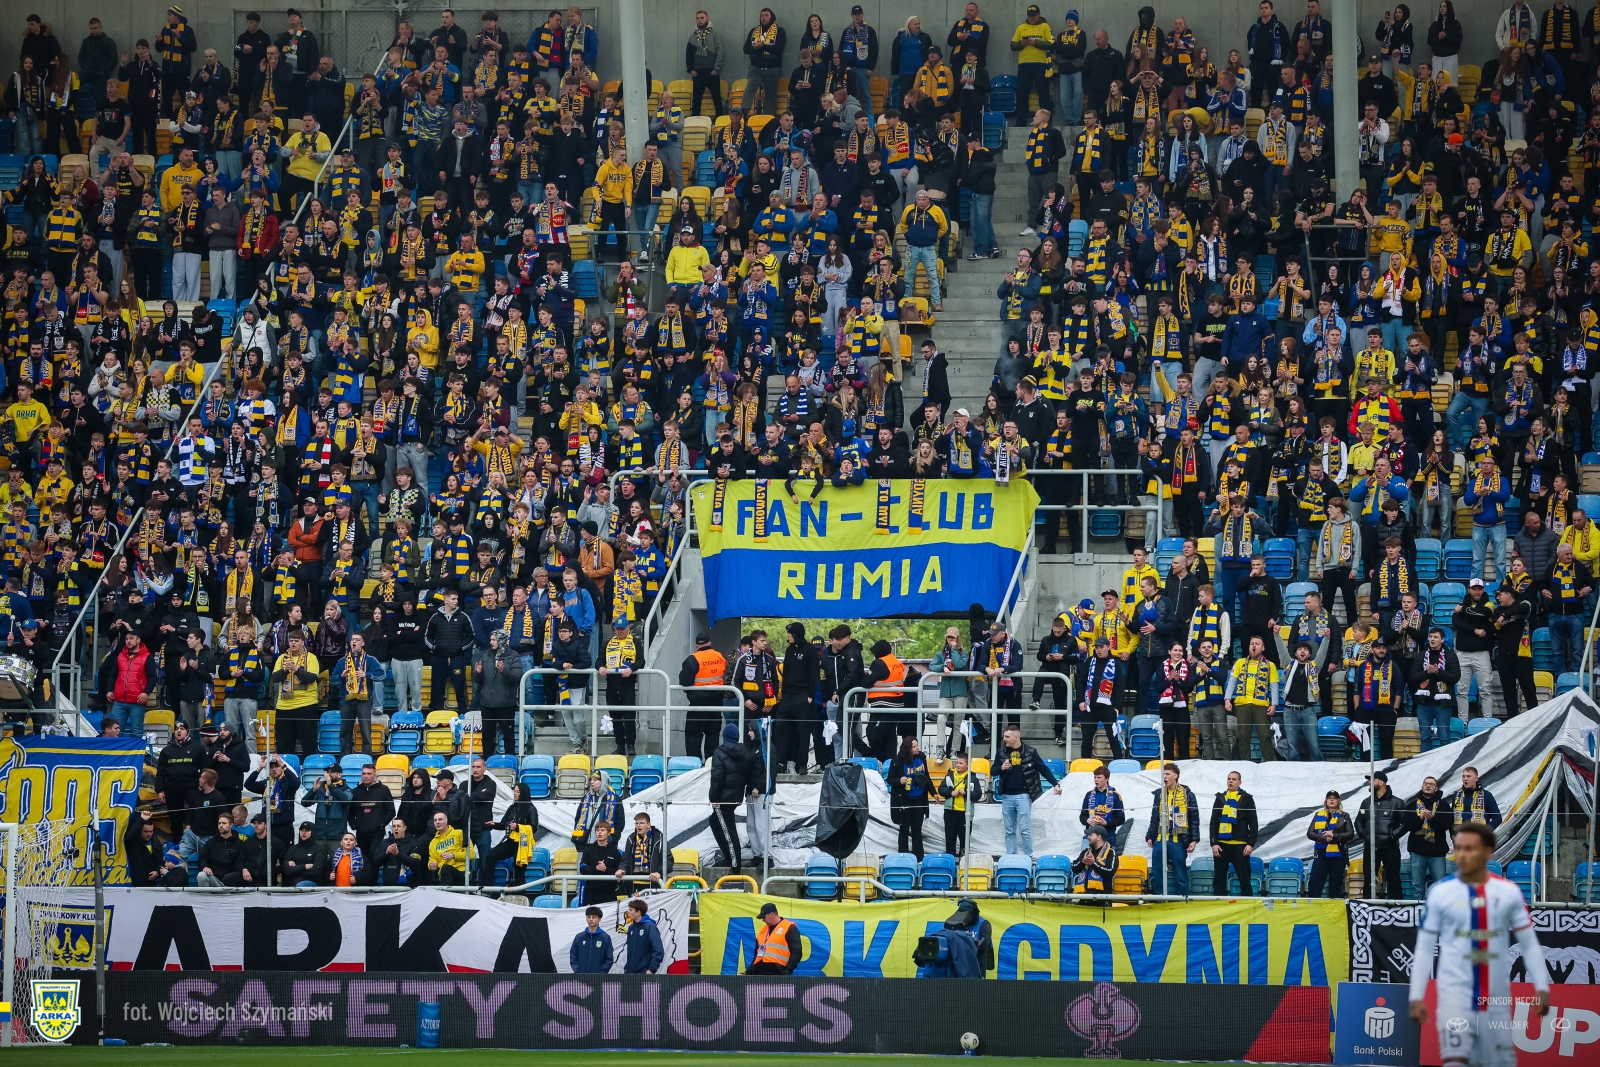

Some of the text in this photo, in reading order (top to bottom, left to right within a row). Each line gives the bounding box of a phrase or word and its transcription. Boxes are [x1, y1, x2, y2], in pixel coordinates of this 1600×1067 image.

[16, 410, 36, 418] ARKA
[755, 485, 766, 535] ARKOWCY
[878, 489, 888, 526] TO MY!
[778, 556, 942, 600] RUMIA
[435, 838, 453, 851] ARKA
[82, 912, 96, 920] KLU
[133, 904, 557, 974] ARKA
[999, 922, 1332, 998] GDYNIA
[168, 978, 853, 1044] SAFETY SHOES
[1354, 1045, 1403, 1056] Bank Polski
